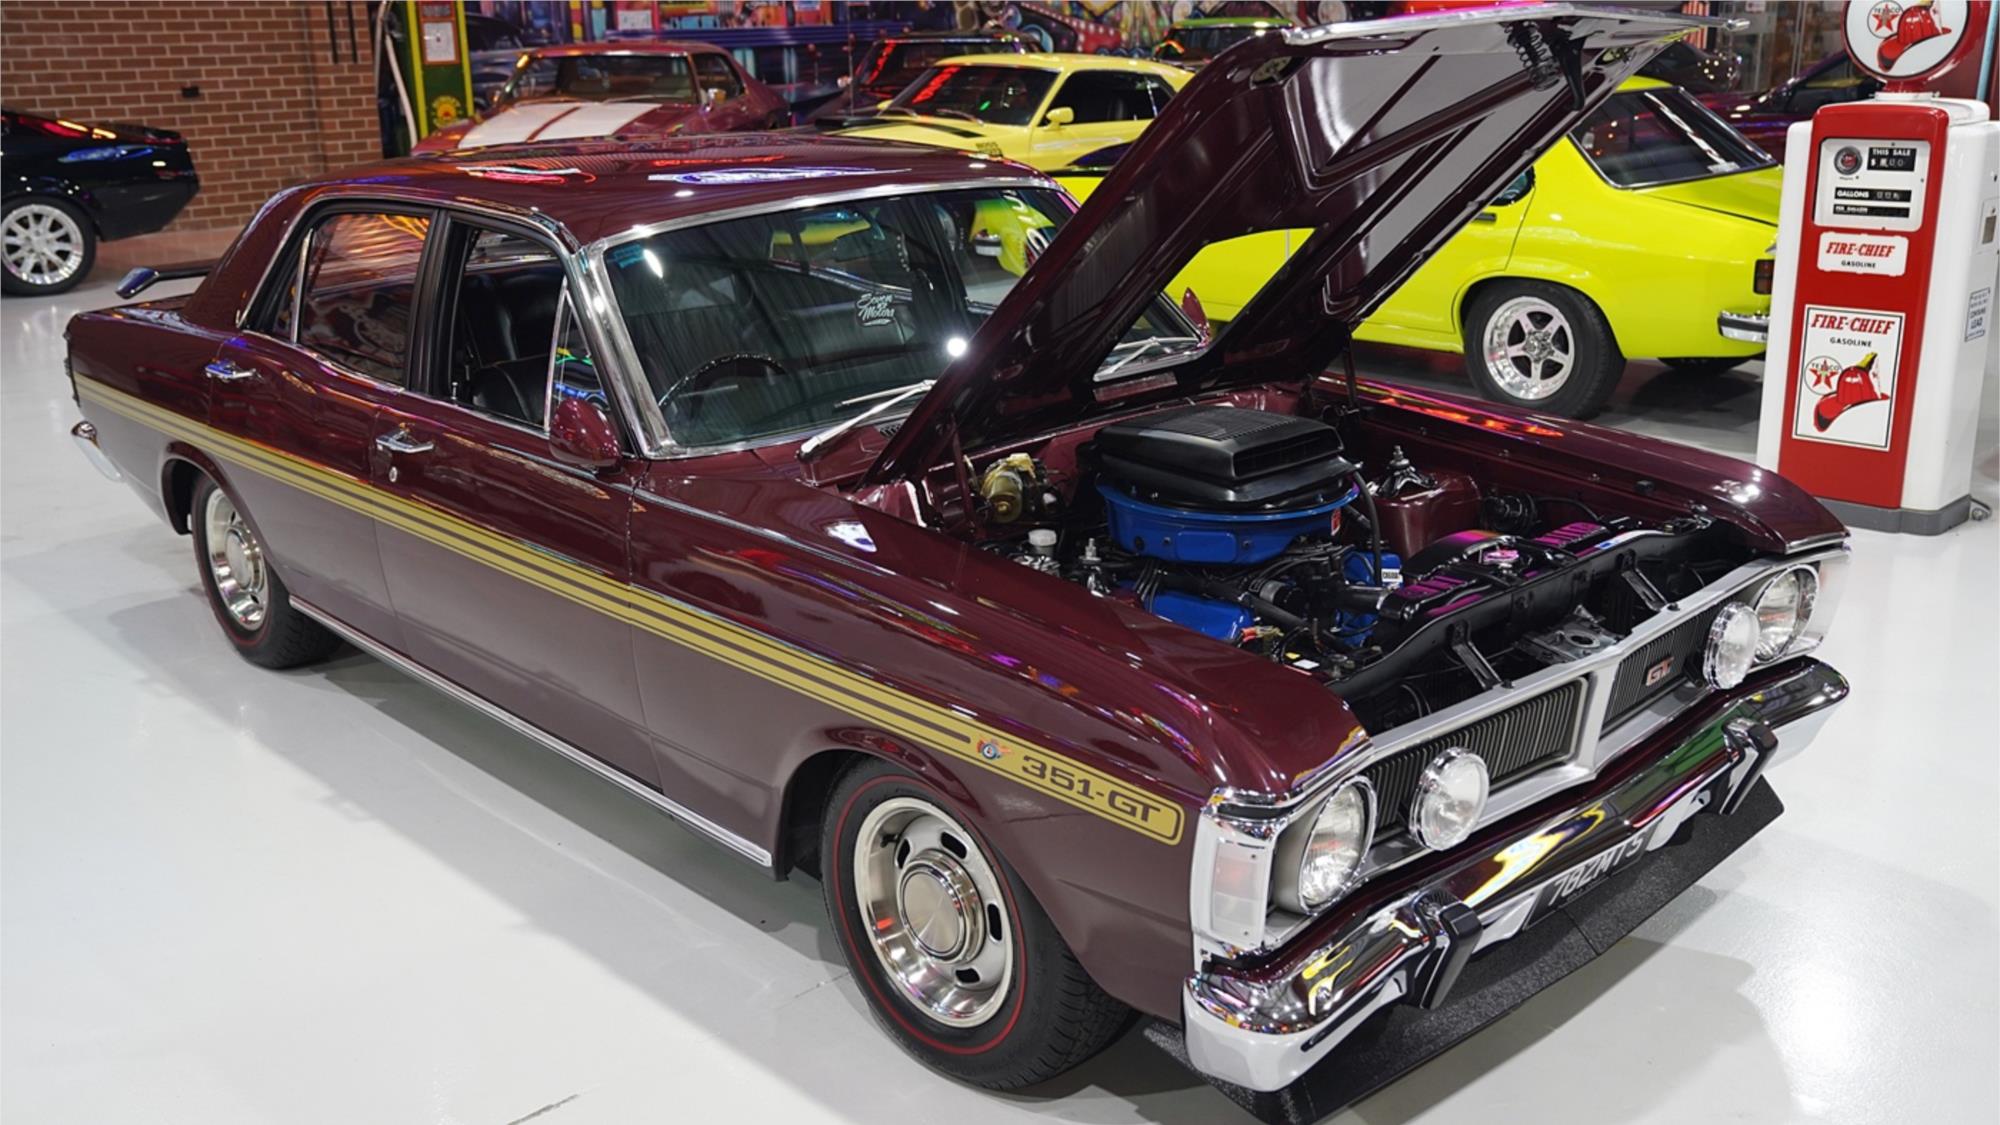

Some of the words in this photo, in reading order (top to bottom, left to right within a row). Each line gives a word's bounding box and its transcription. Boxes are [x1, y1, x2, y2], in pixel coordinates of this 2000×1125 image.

[1836, 190, 1870, 198] GALLONS
[1825, 241, 1896, 259] FIRE-CHIEF
[1841, 259, 1877, 269] GASOLINE
[858, 306, 896, 321] Motors
[1810, 313, 1896, 336] FIRE-CHIEF
[1829, 336, 1873, 348] GASOLINE
[1645, 656, 1675, 687] GT
[1021, 754, 1161, 824] 351-GT
